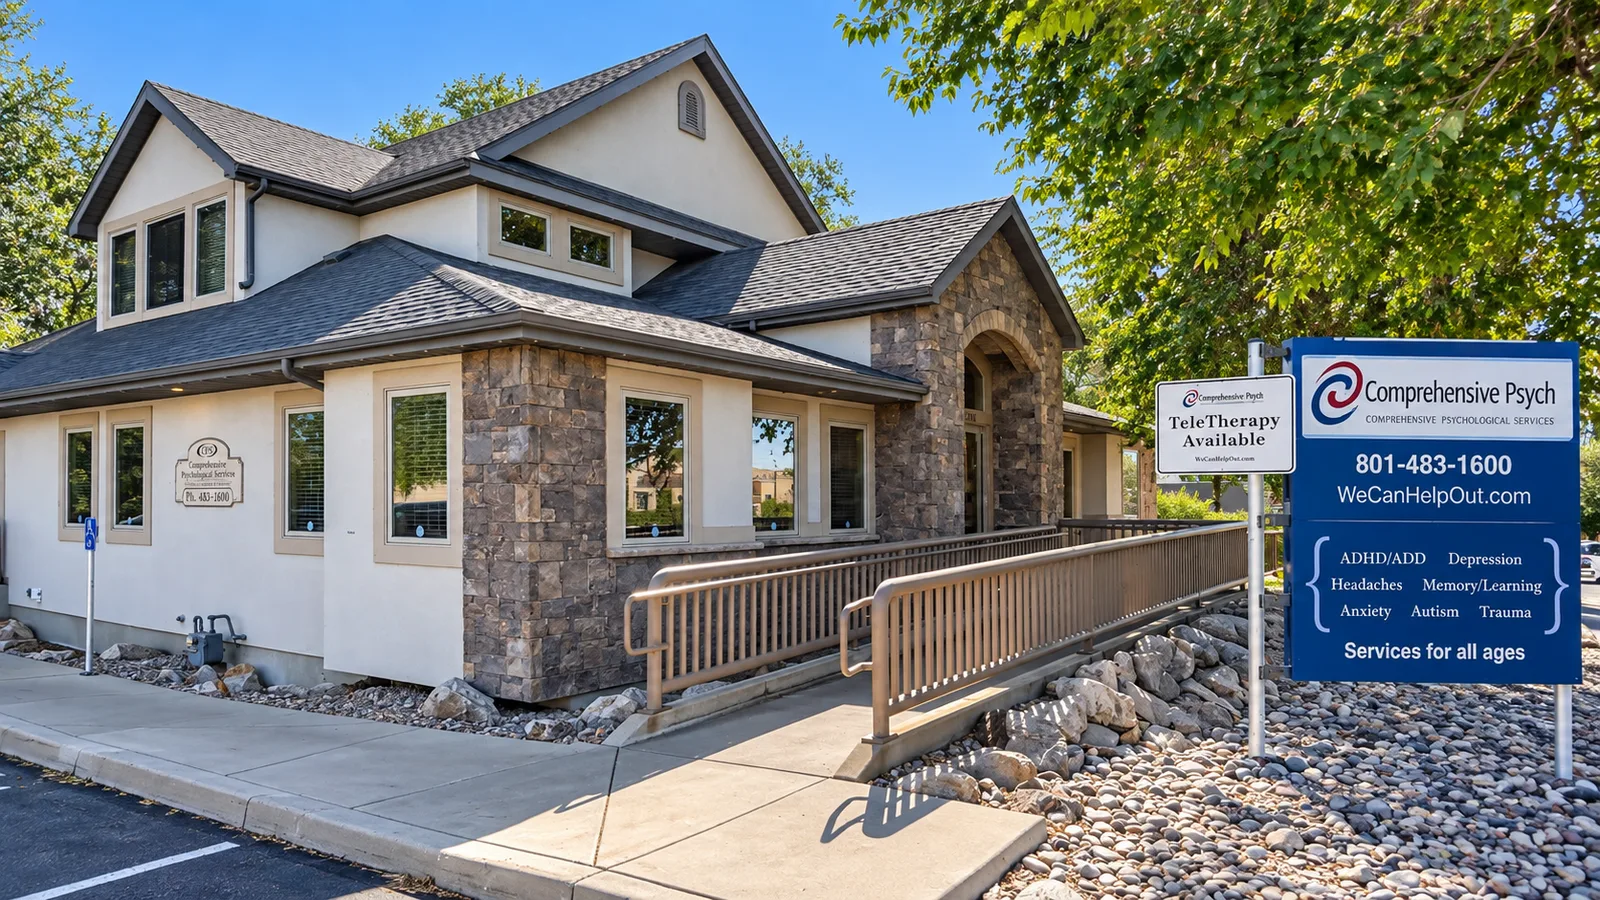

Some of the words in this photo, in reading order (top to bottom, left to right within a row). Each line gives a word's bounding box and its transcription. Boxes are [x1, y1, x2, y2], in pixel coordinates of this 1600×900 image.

[1198, 393, 1244, 403] Comprehensive
[1365, 379, 1500, 409] Comprehensive
[1505, 381, 1556, 410] Psych
[1168, 414, 1281, 430] TeleTherapy
[1365, 415, 1437, 424] COMPREHENSIVE
[1441, 416, 1511, 425] PSYCHOLOGICAL
[1513, 417, 1555, 426] SERVICES
[1182, 432, 1266, 448] Available
[1355, 453, 1513, 476] 801-483-1600
[185, 491, 197, 502] Ph.
[1337, 485, 1532, 508] WeCanHelpOut.com
[1340, 551, 1427, 566] ADHD/ADD
[1448, 552, 1523, 568] Depression
[1331, 578, 1403, 591] Headaches
[1422, 578, 1543, 595] Memory/Learning
[1340, 604, 1392, 620] Anxiety
[1411, 605, 1460, 618] Autism
[1479, 605, 1533, 619] Trauma
[1344, 641, 1422, 660] Services
[1425, 642, 1452, 660] for
[1456, 643, 1477, 660] all
[1482, 646, 1526, 664] ages
